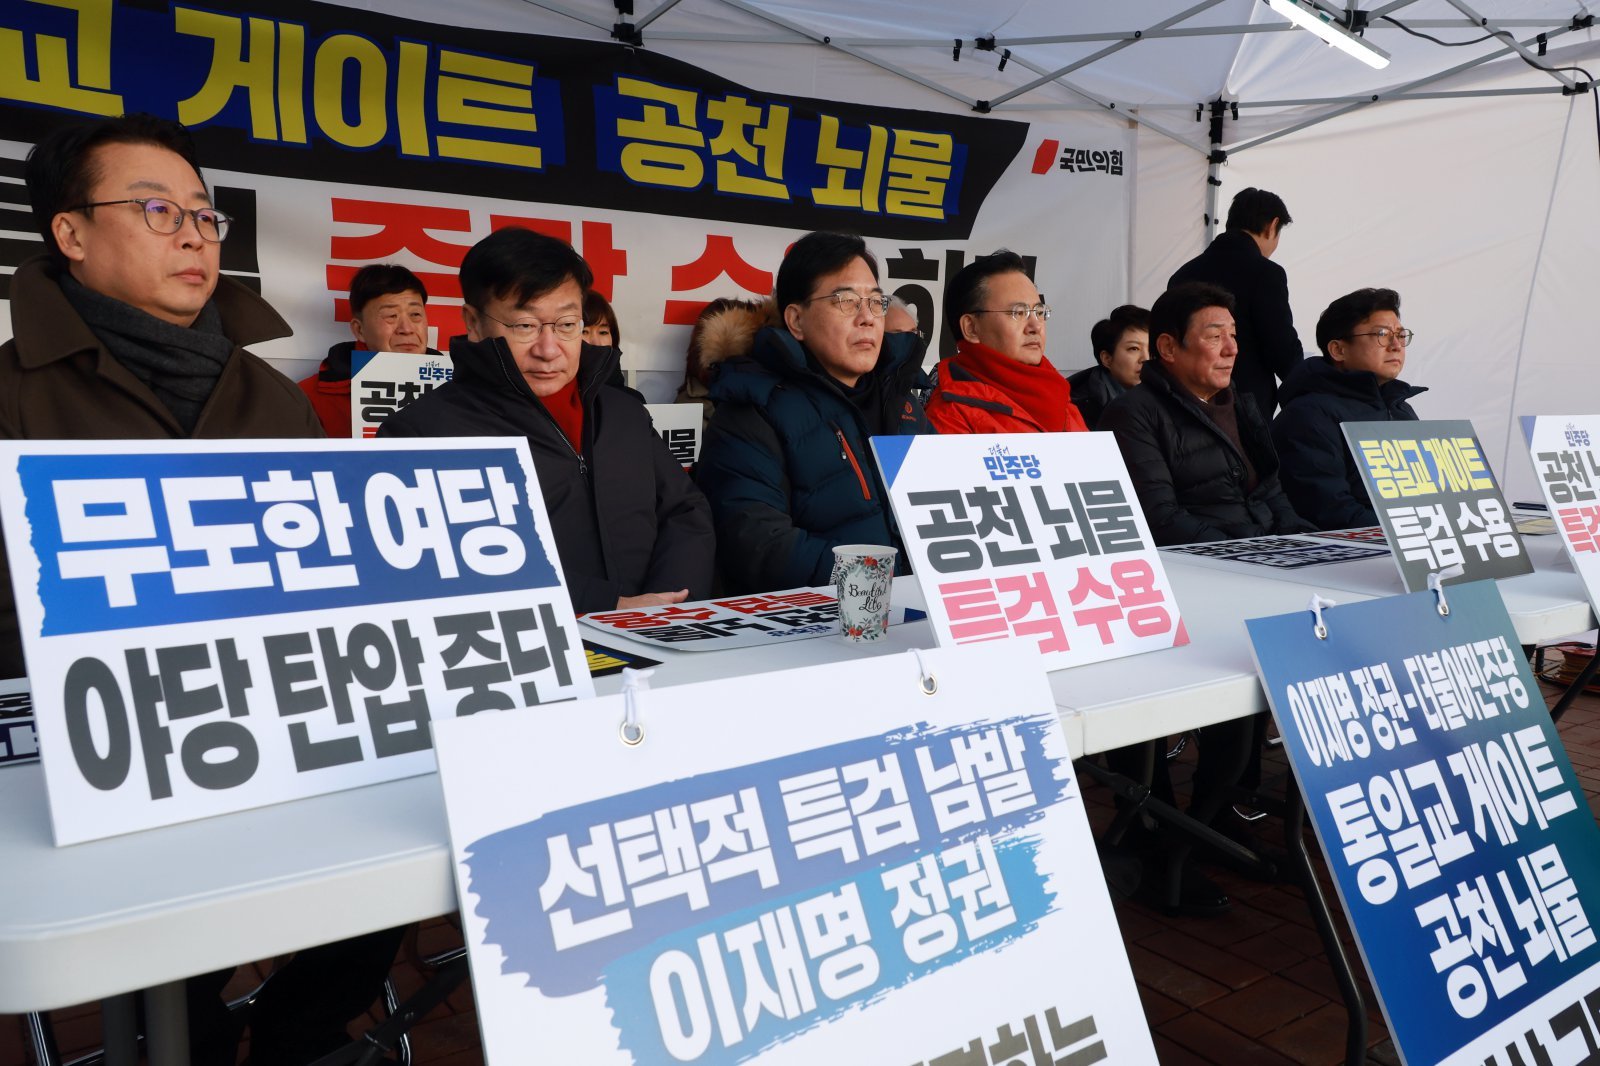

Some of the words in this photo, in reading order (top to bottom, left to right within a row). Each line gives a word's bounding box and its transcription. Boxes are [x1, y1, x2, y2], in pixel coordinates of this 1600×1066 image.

[175, 7, 541, 168] 게이트
[617, 76, 790, 200] 공천
[811, 115, 953, 220] 뇌물
[1060, 148, 1123, 176] 국민의힘
[663, 429, 697, 463] 물
[983, 455, 1042, 480] 민주당
[1358, 439, 1438, 499] 통일교
[1422, 437, 1494, 493] 게이트
[1537, 450, 1597, 504] 공천
[1564, 430, 1591, 447] 민주당
[51, 470, 360, 608] 무도한
[365, 467, 526, 579] 여당
[907, 486, 1041, 573] 공천
[1031, 480, 1145, 559] 뇌물
[1386, 503, 1465, 569] 특검
[1457, 498, 1520, 562] 수용
[588, 607, 718, 629] 수용
[627, 618, 775, 642] 뇌물
[1068, 559, 1171, 645] 수용
[64, 637, 259, 800] 야당
[263, 619, 432, 773] 탄압
[433, 603, 578, 708] 중단
[1287, 672, 1371, 767] 이재명
[540, 788, 779, 952] 선택적
[780, 754, 918, 864] 특검
[916, 724, 1036, 833] 남발
[1325, 760, 1475, 905] 통일교
[1450, 725, 1578, 847] 게이트
[650, 883, 880, 1062] 이재명
[882, 834, 1017, 965] 정권
[1414, 870, 1527, 1019] 공천
[1497, 843, 1597, 967] 뇌물
